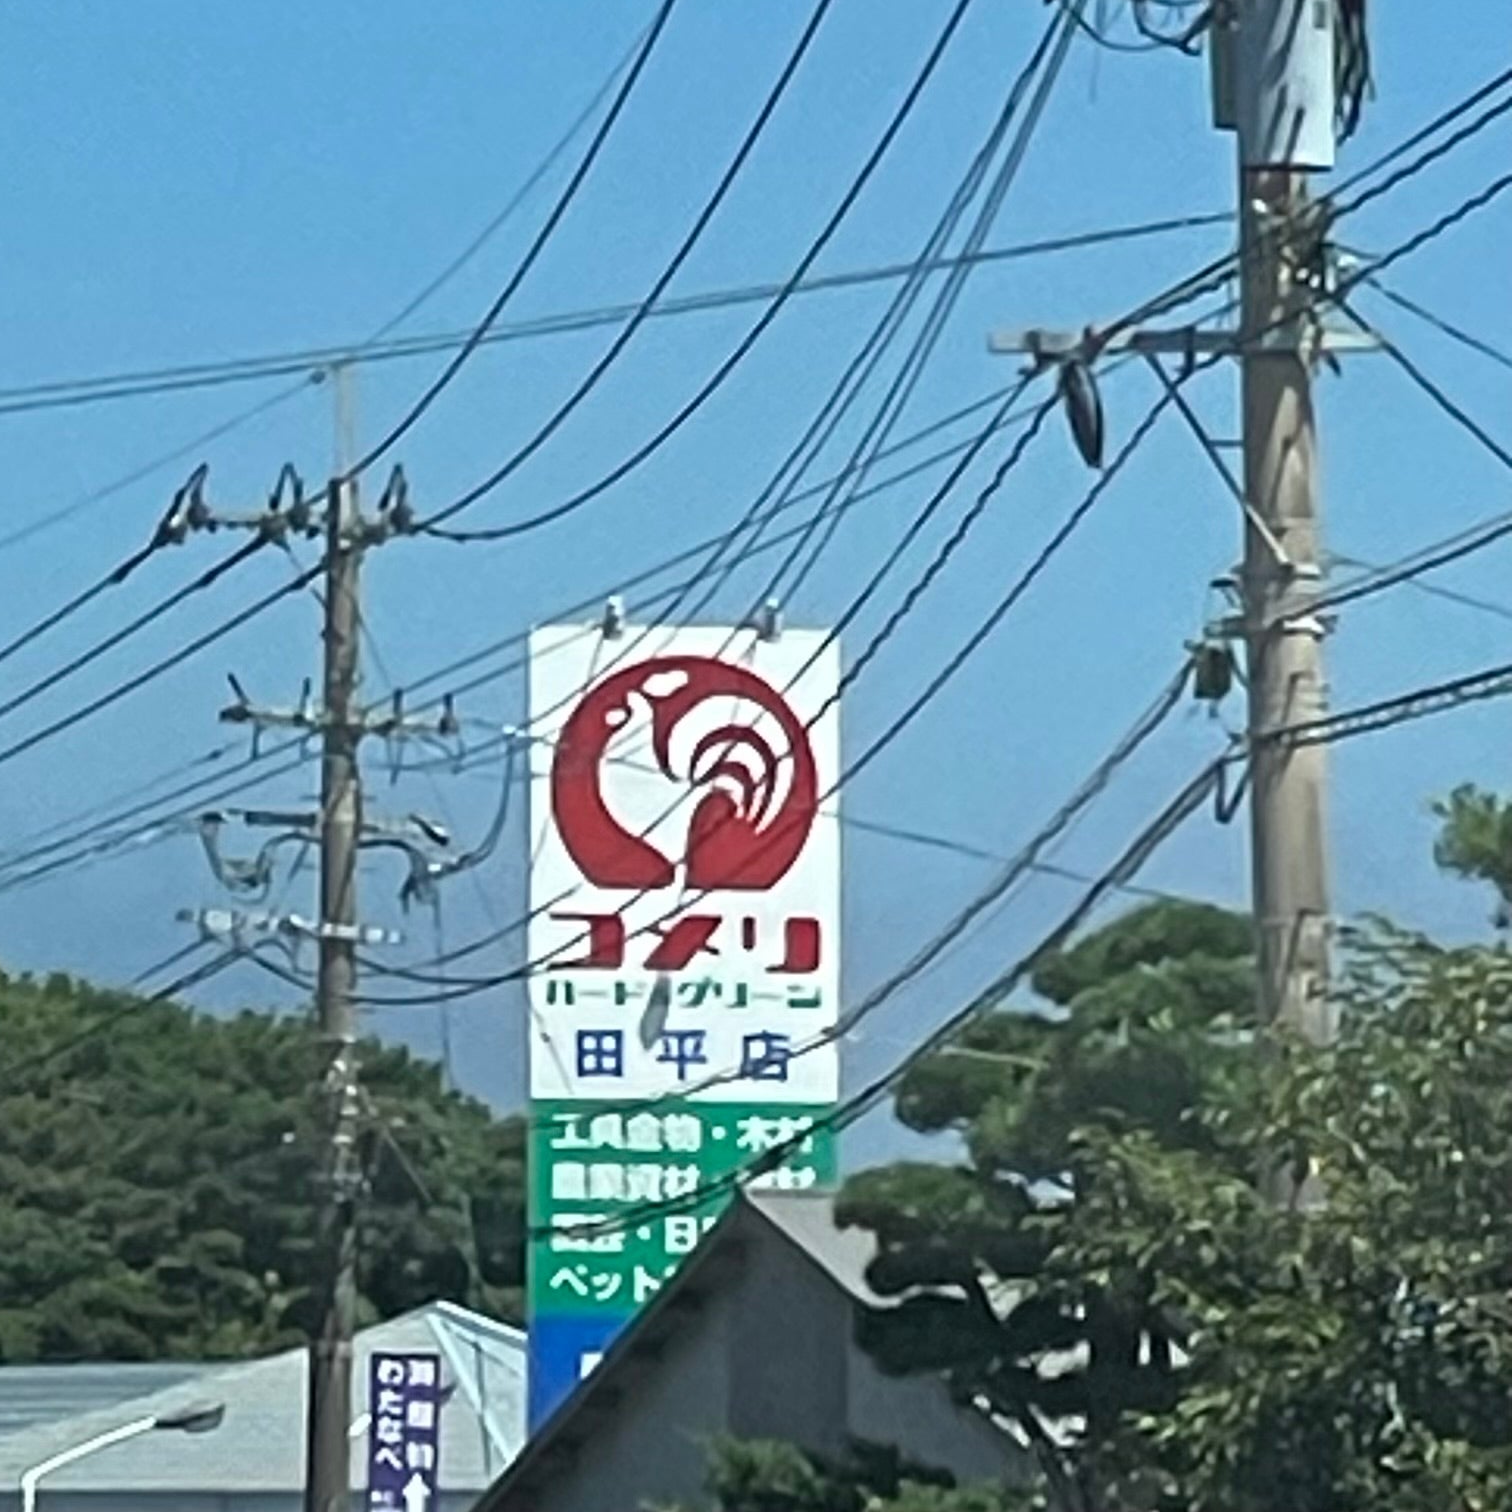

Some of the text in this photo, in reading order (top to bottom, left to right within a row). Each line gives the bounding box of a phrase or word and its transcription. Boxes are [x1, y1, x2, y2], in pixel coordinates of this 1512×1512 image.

[546, 913, 821, 973] コメリ
[546, 976, 822, 1009] ハードグリーン
[576, 1029, 792, 1082] 田平店
[549, 1264, 677, 1303] ペット
